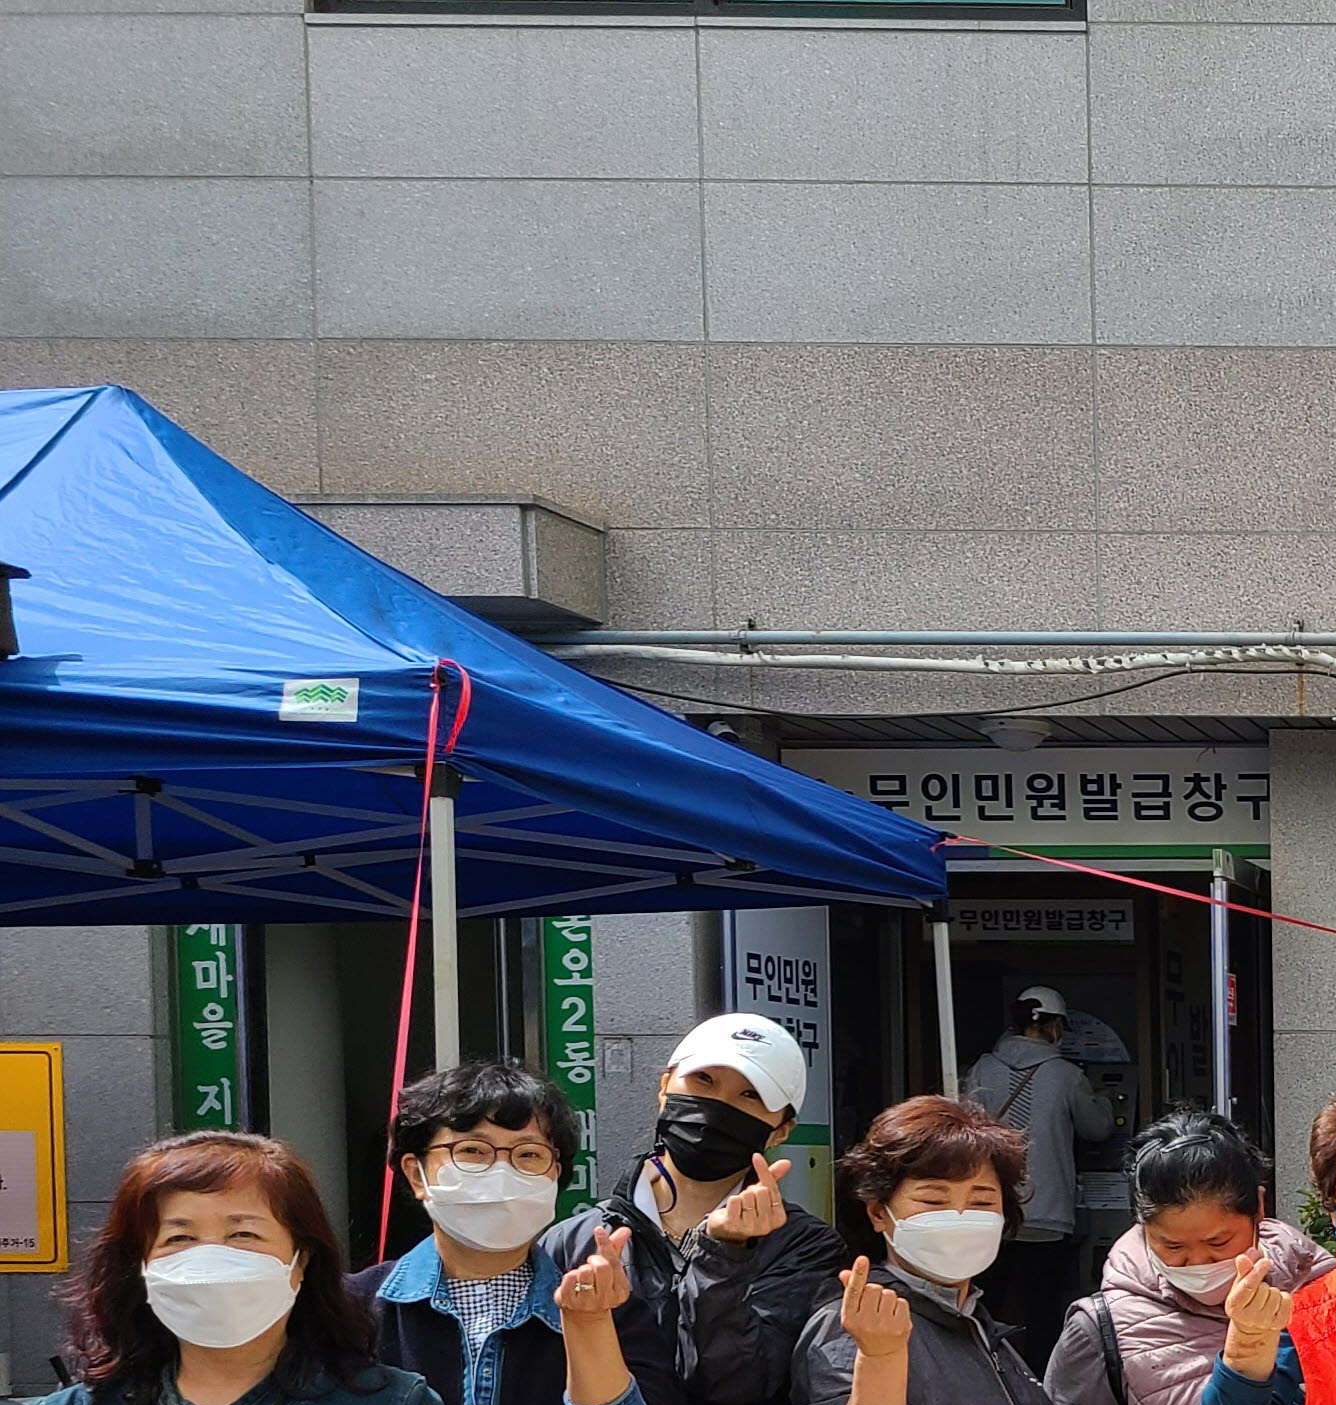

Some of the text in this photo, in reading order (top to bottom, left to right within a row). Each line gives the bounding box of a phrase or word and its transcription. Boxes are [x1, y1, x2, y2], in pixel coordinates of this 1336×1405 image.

[868, 772, 1270, 822] 무인민원발급창구
[959, 909, 1128, 932] 무인민원발급창구
[745, 952, 818, 1008] 무인민원
